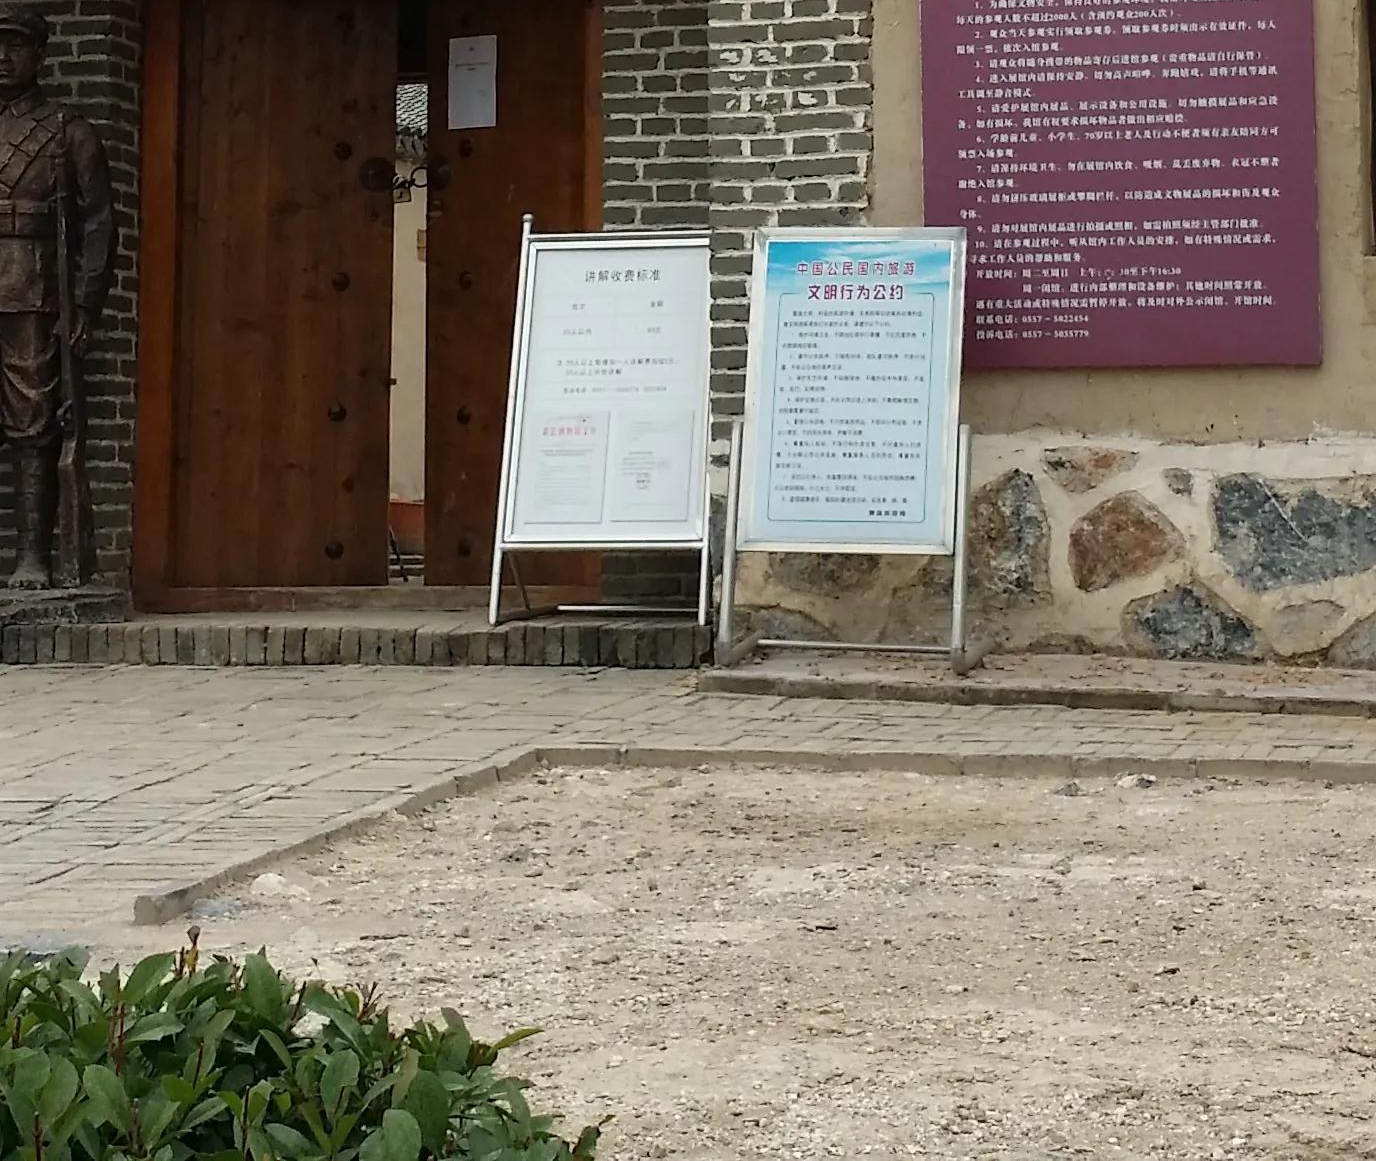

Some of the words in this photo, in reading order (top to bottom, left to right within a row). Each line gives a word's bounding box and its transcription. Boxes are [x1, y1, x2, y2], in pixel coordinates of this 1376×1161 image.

[585, 268, 661, 283] 讲解收费标准
[797, 261, 916, 276] 中国公民国内旅游
[807, 284, 904, 300] 文明行为公约
